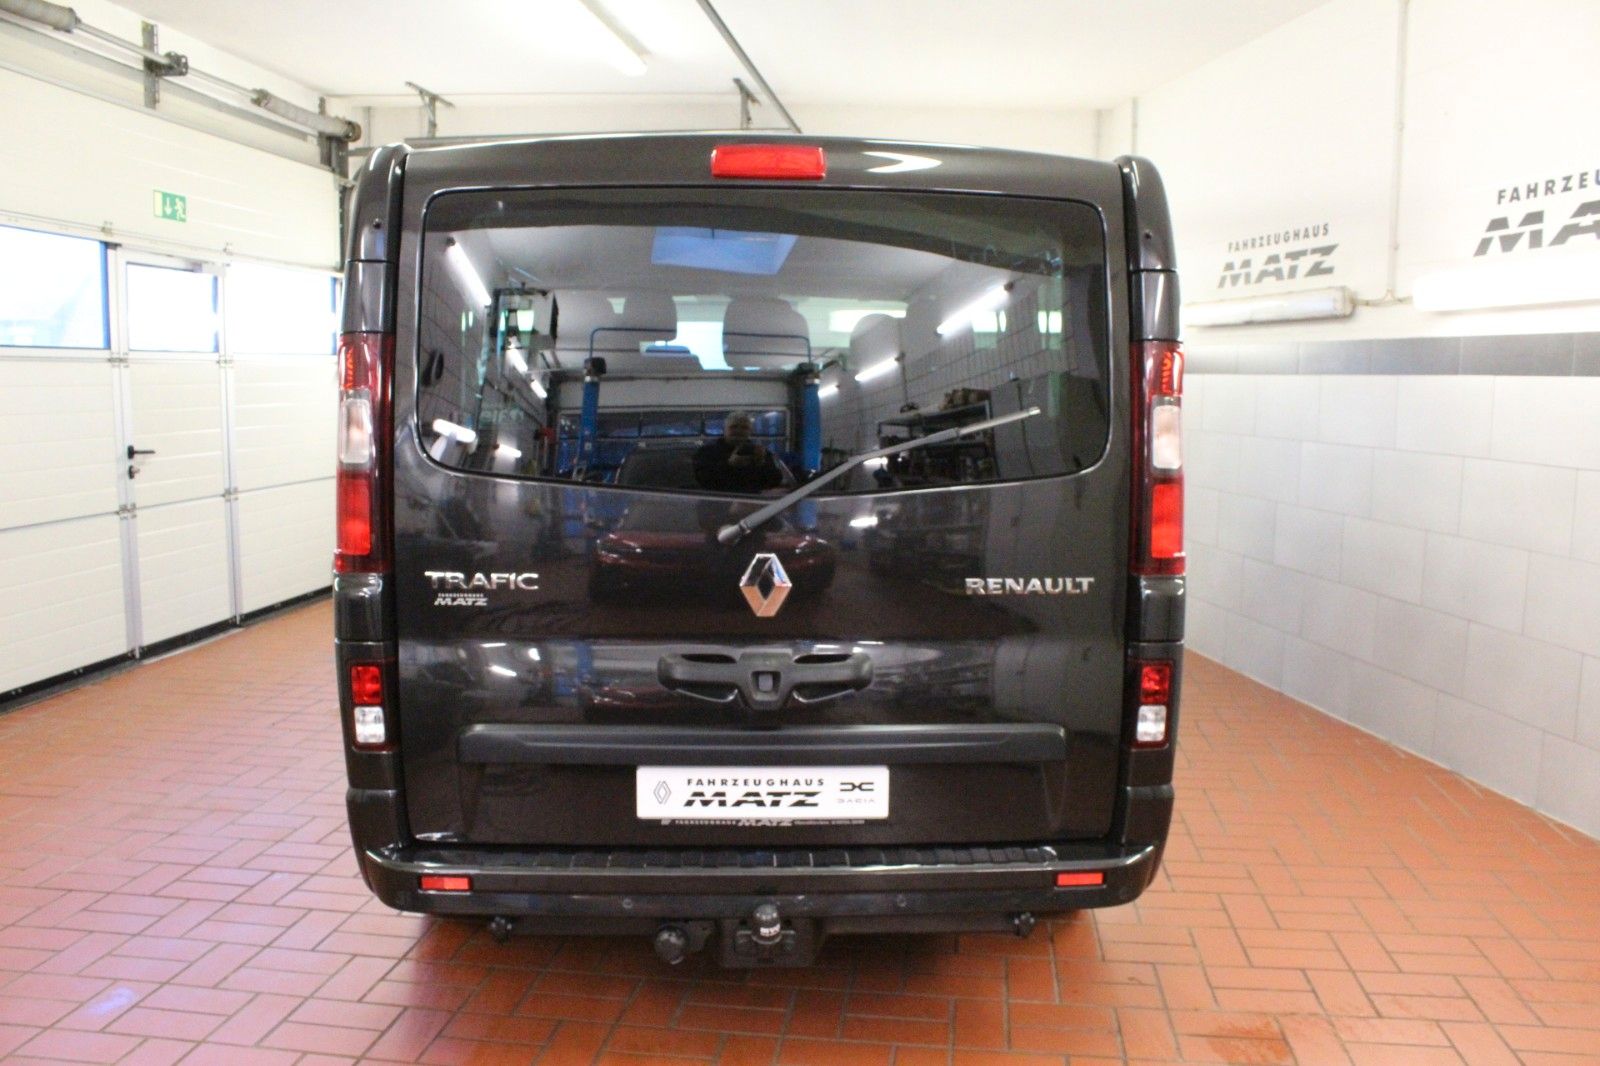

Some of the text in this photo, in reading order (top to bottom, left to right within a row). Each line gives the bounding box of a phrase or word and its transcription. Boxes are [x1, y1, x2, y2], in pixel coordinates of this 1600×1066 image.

[1228, 223, 1329, 253] FAHRZEUGHAUS
[1217, 243, 1339, 289] MATZ
[424, 570, 539, 590] TRAFIC
[964, 577, 1095, 595] RENAULT
[433, 597, 488, 606] MATZ
[687, 778, 824, 787] FAHRZEUGHAUS
[683, 791, 821, 807] MATZ
